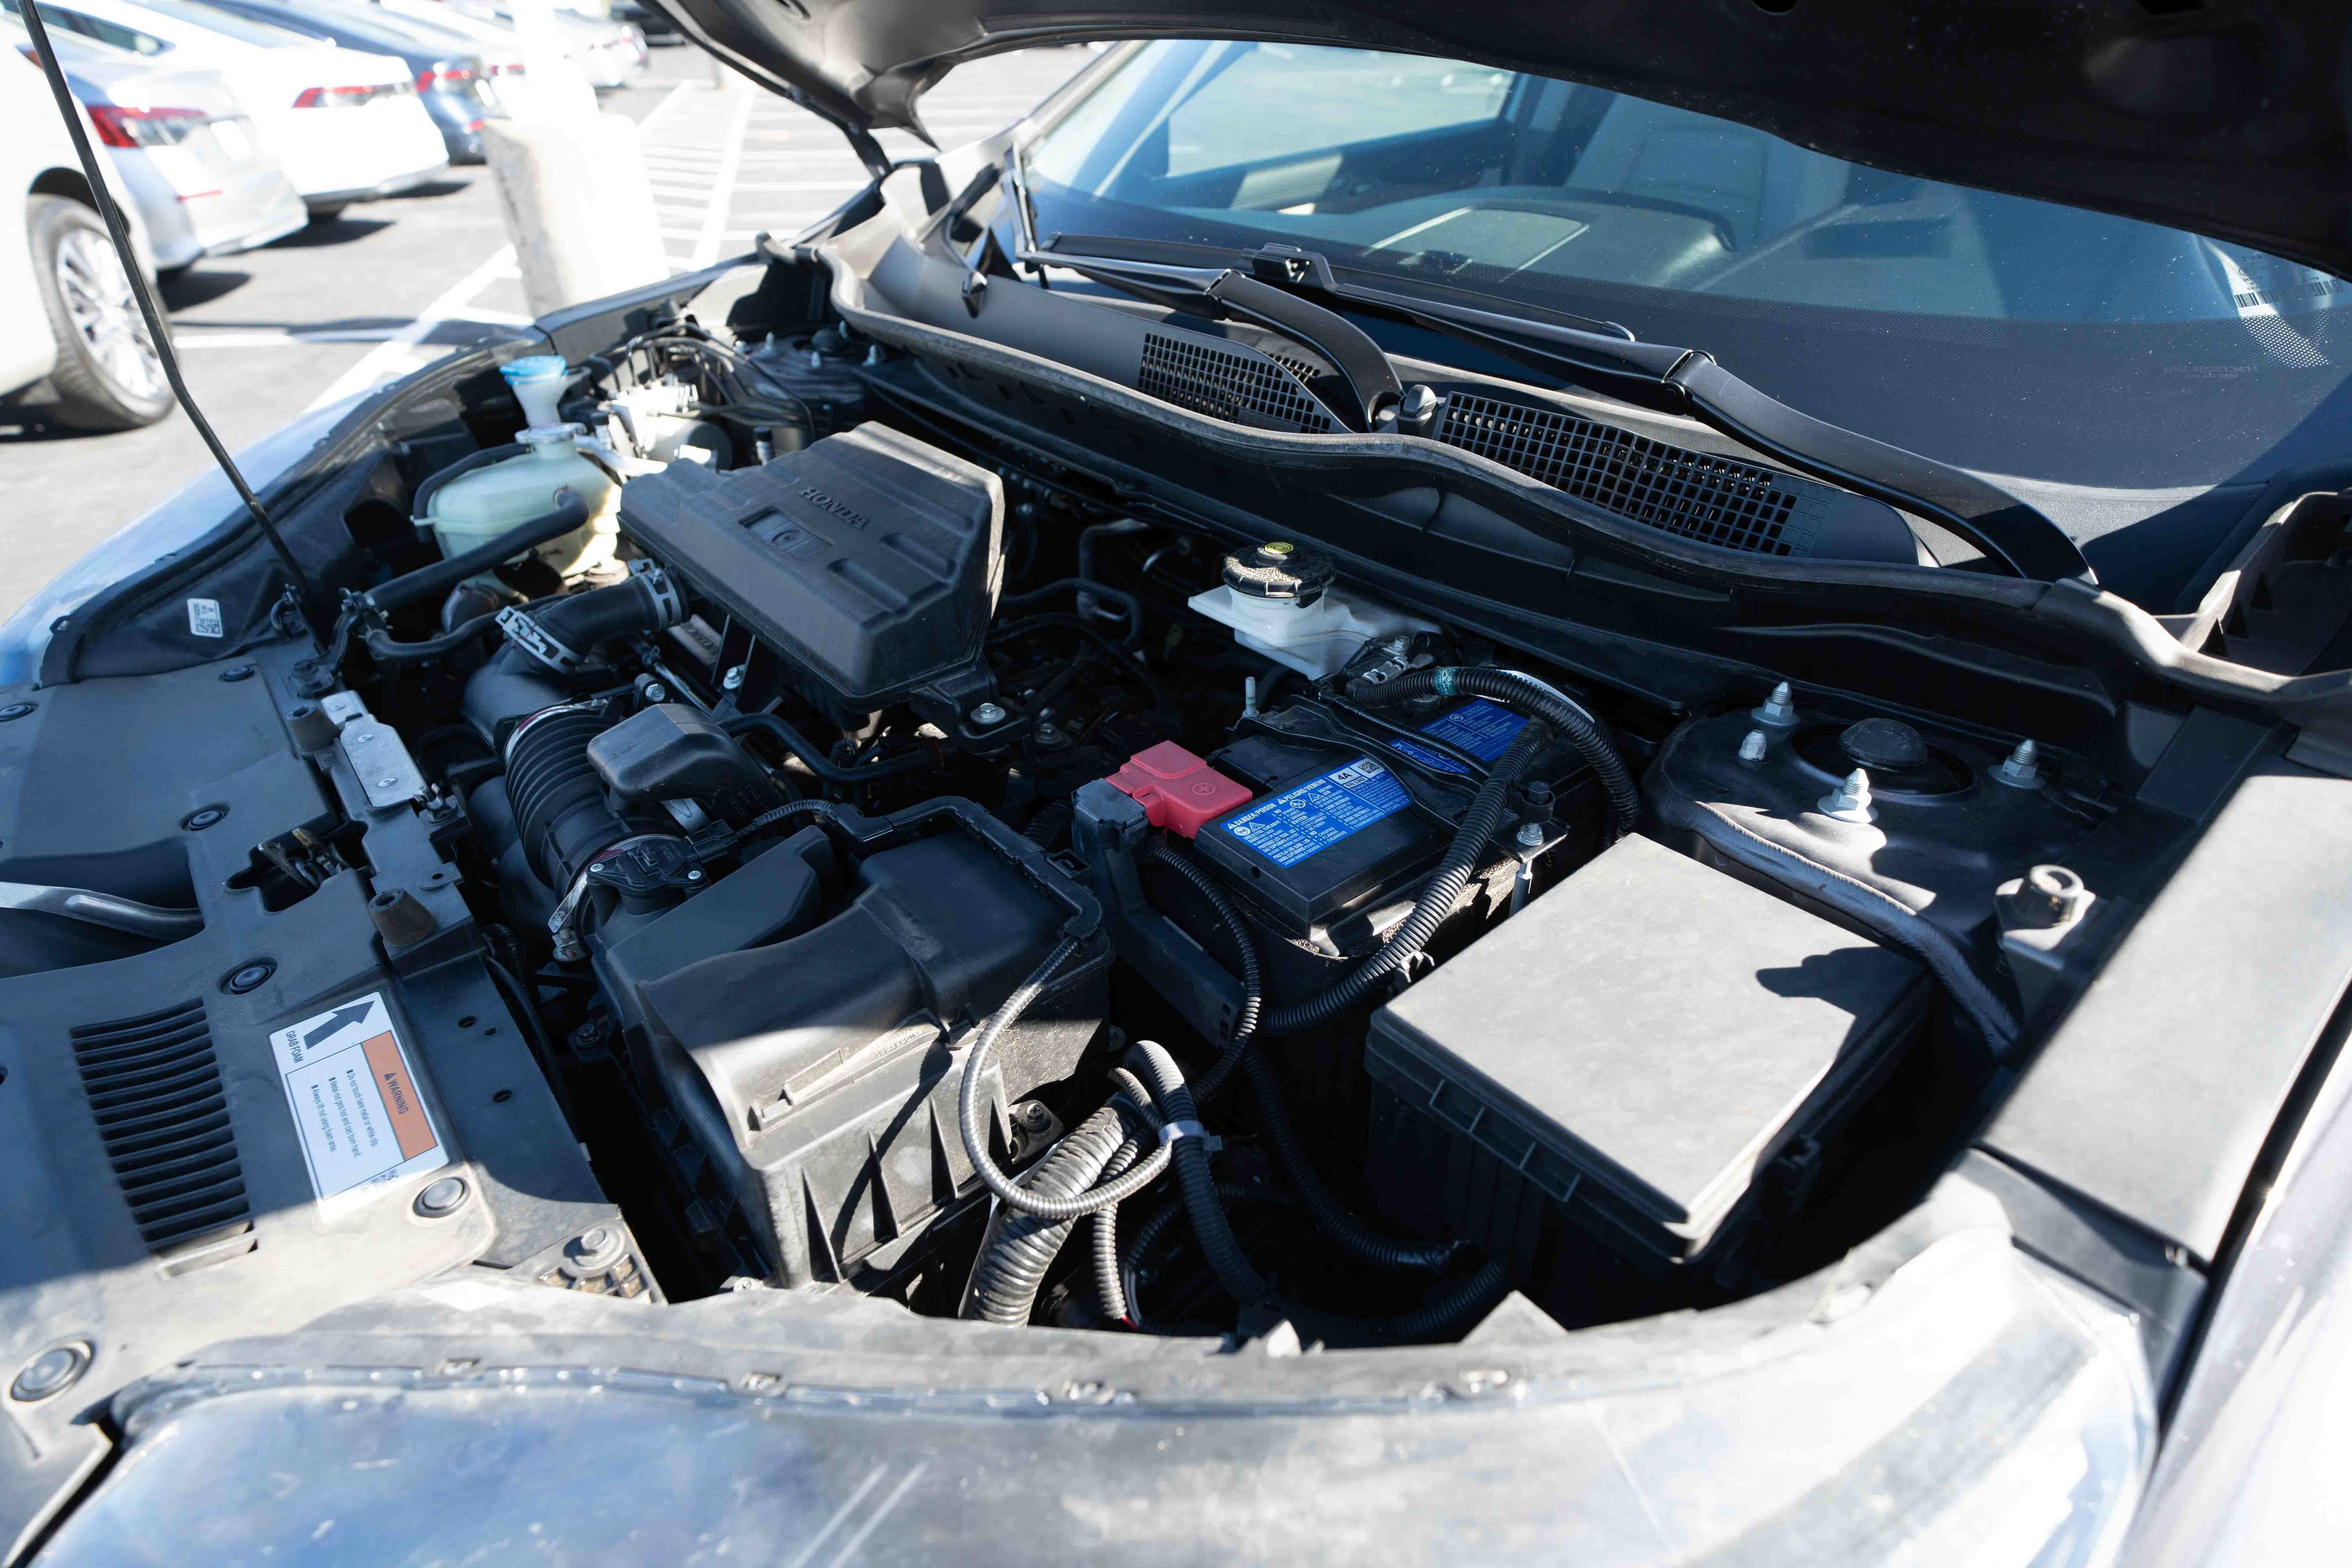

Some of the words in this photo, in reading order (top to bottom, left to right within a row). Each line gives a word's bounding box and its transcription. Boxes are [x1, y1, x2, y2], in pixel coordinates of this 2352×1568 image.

[797, 486, 870, 530] HONDA
[1350, 773, 1385, 791] 31500-TLA-A11
[1283, 779, 1325, 801] PELIGRO/VENENO
[1234, 803, 1276, 826] DANGER/POISON
[1291, 815, 1308, 824] ÉVITER
[1318, 827, 1335, 836] CHISPAS
[1322, 830, 1339, 839] FLAMAS
[1327, 831, 1347, 842] CIGARROS
[1273, 850, 1289, 859] PROTEJA
[285, 1030, 300, 1048] GRAB
[290, 1045, 304, 1064] FOAM
[346, 1072, 356, 1081] Do
[349, 1079, 359, 1088] not
[330, 1080, 339, 1094] Metal
[351, 1085, 362, 1100] touch
[312, 1088, 322, 1105] Always
[333, 1092, 343, 1101] rod
[355, 1097, 365, 1110] bare
[388, 1079, 409, 1115] WARNING
[333, 1099, 345, 1111] gets
[318, 1108, 327, 1118] rod
[339, 1108, 348, 1118] hot
[359, 1107, 370, 1121] metal
[320, 1116, 330, 1131] using
[341, 1116, 352, 1127] and
[324, 1127, 334, 1142] foam
[344, 1125, 354, 1135] can
[365, 1125, 376, 1139] white
[347, 1132, 356, 1146] burn
[351, 1144, 362, 1158] hand.
